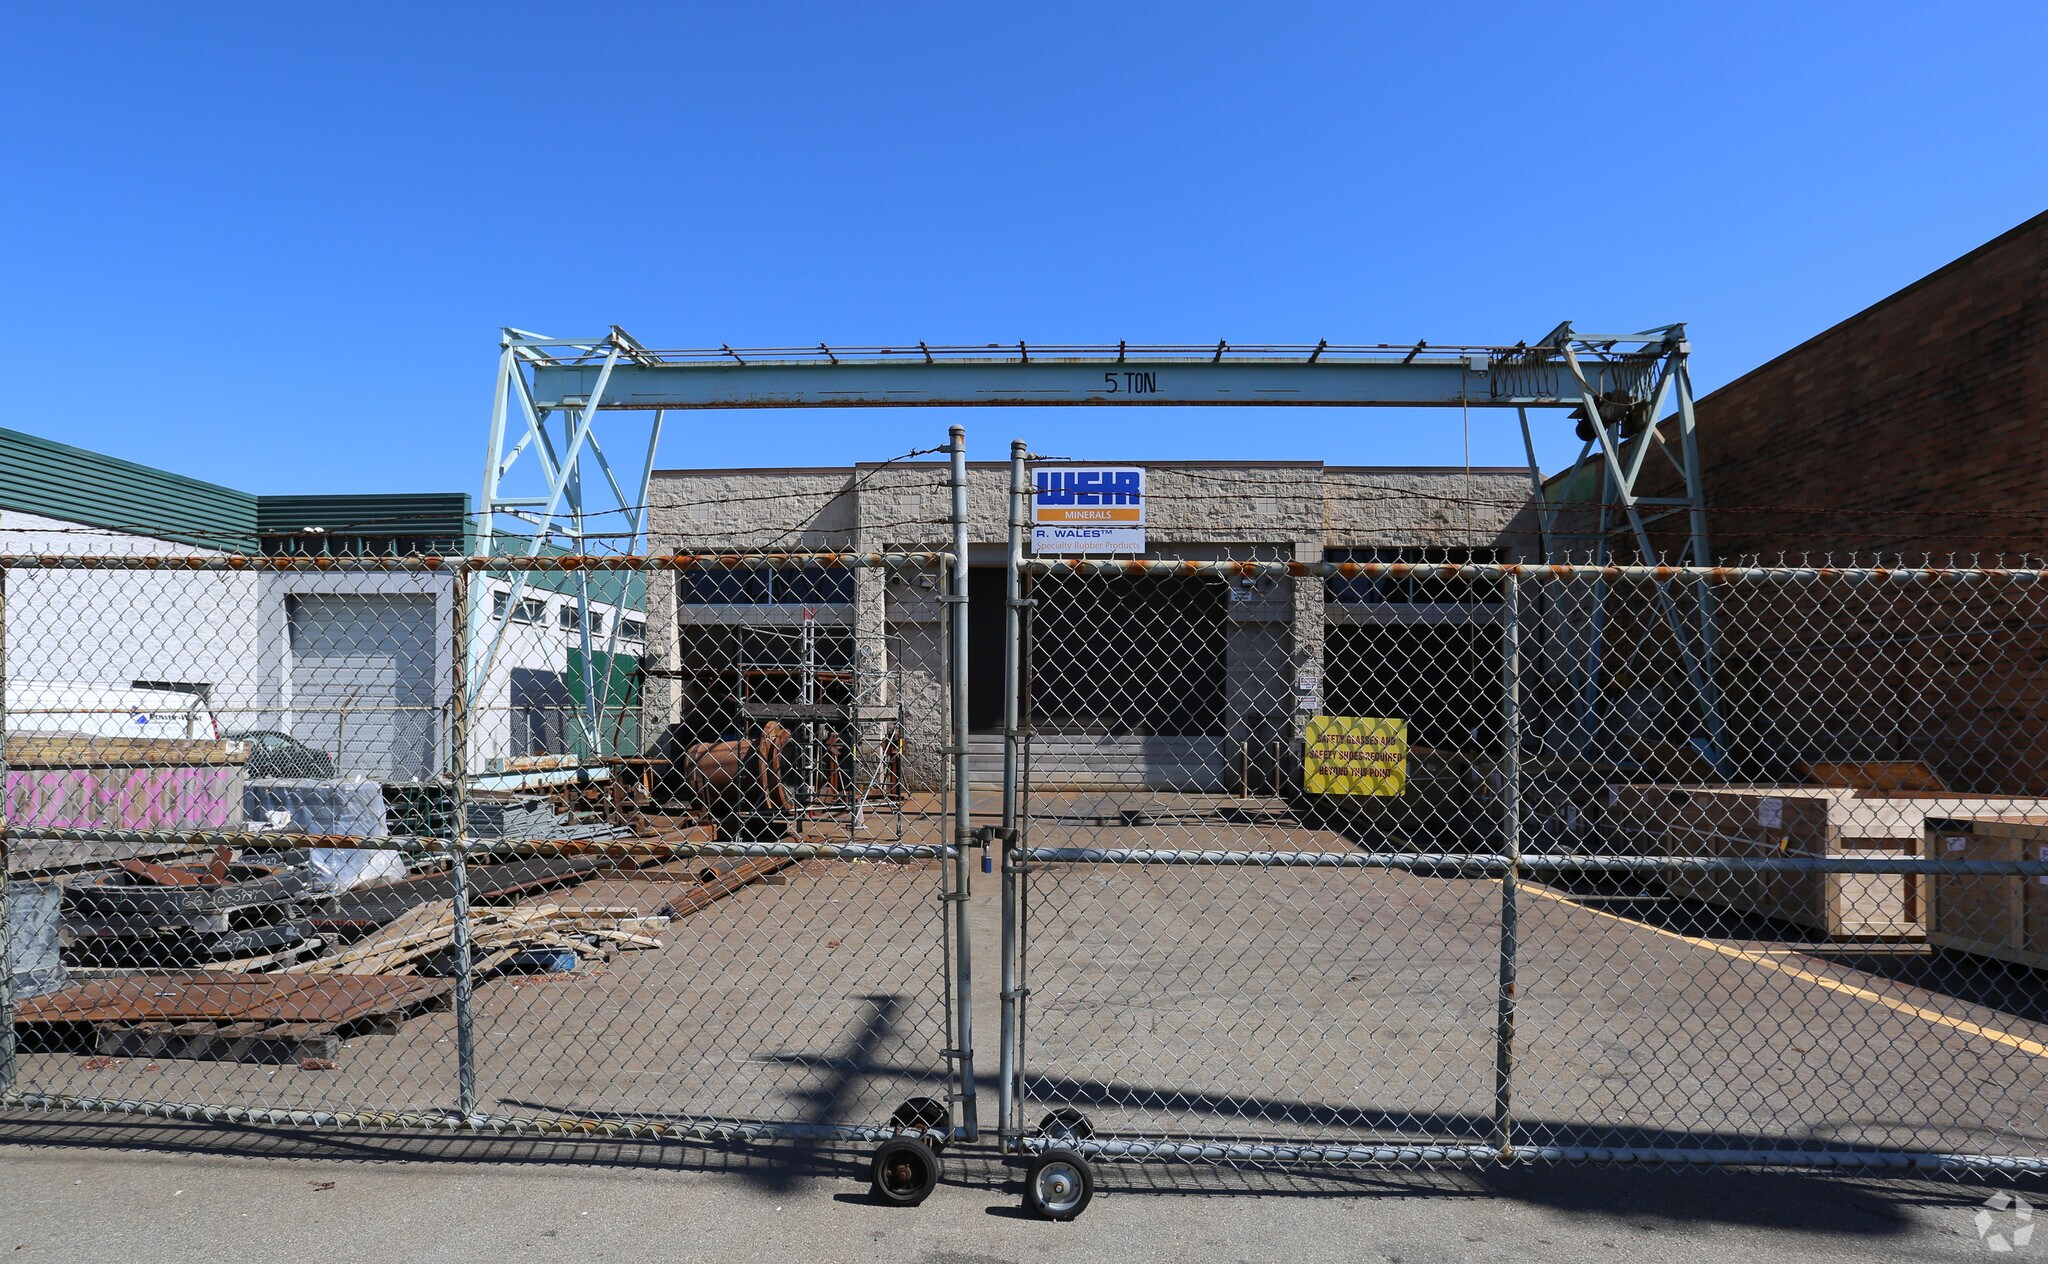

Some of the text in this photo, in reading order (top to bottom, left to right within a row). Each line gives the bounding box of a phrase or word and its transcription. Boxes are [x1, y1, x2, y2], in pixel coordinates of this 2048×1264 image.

[1104, 372, 1156, 393] 5 TON
[1037, 472, 1140, 505] WEIR
[1064, 510, 1112, 519] MINERALS
[1036, 530, 1050, 538] R.
[1036, 541, 1140, 550] Specialty Rubber Products
[1317, 734, 1396, 746] SAFETY GLASSES AND
[1309, 749, 1337, 760] SAFETY
[1339, 751, 1364, 761] SHOES
